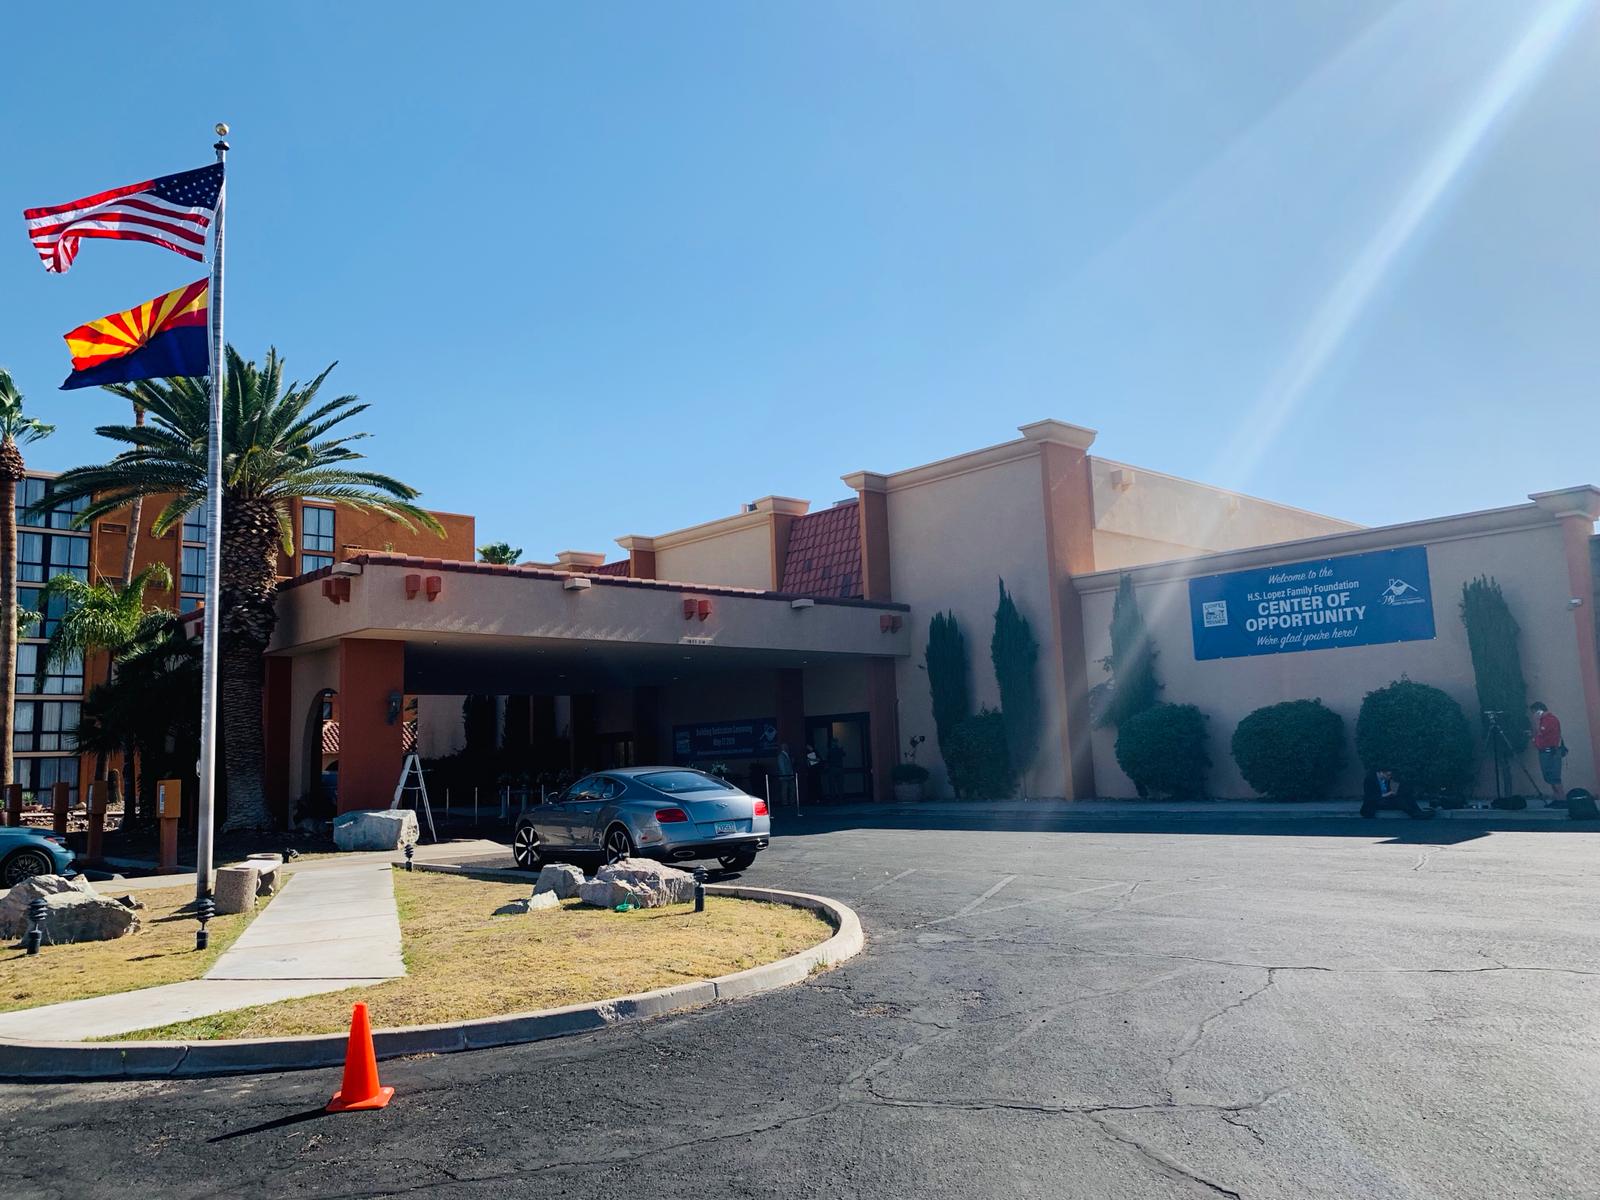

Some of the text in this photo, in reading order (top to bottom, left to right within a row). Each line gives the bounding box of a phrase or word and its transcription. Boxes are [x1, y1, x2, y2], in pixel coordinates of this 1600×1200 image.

[1268, 566, 1333, 584] Welcome to the
[1247, 580, 1359, 601] H.S. Lopez Family Foundation
[1258, 592, 1350, 616] CENTER OF
[1245, 605, 1366, 631] OPPORTUNITY
[1280, 631, 1301, 649] glad
[1331, 626, 1358, 639] here!
